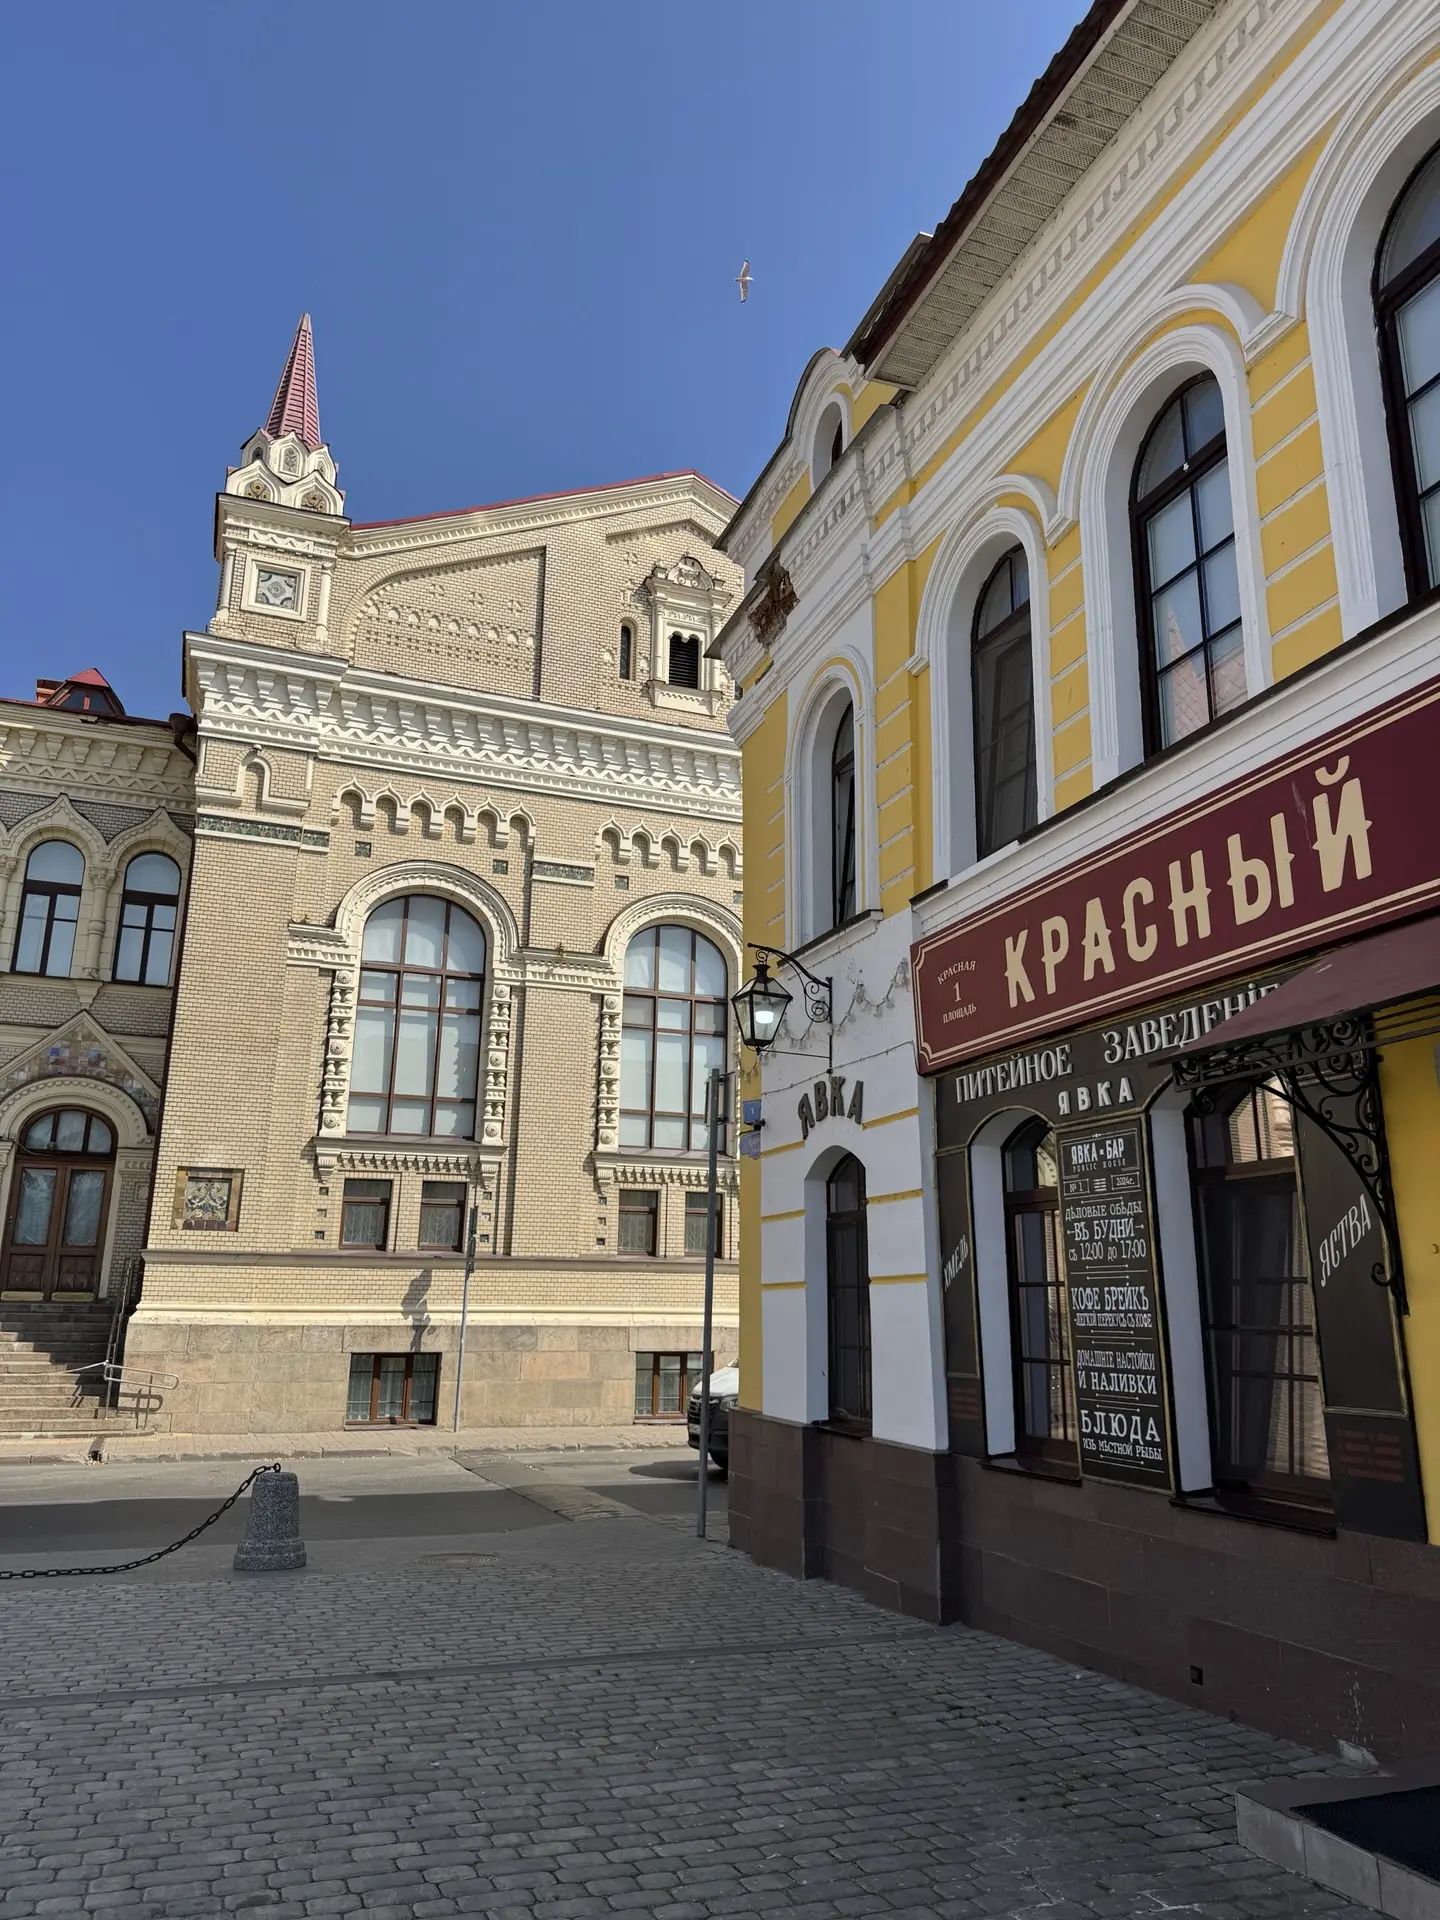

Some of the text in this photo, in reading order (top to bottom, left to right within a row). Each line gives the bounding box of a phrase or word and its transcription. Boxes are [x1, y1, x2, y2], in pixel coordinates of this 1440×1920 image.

[1004, 755, 1373, 1008] КРАСНЫЙ
[937, 960, 976, 985] КРАСНАЯ
[953, 981, 962, 1002] 1
[942, 1003, 977, 1024] ПЛОЩАДЬ
[955, 1044, 1073, 1103] ПИТЕЙНОЕ
[798, 1076, 864, 1140] ЯВКА
[1058, 1077, 1134, 1115] ЯВКА
[1073, 1158, 1126, 1172] PUBLIC HOUSE
[1074, 1217, 1135, 1242] ВЪ БУДНИ
[1319, 1193, 1371, 1288] ЯСТВА
[1080, 1241, 1104, 1260] 12:00
[1120, 1239, 1147, 1259] 17:00
[943, 1234, 968, 1291] ХМЕЛЬ
[1071, 1282, 1149, 1311] КОФЕ БРЕЙКЪ
[1115, 1349, 1156, 1371] НАСТОЙКИ
[1078, 1370, 1157, 1395] И НАЛИВКИ
[1080, 1409, 1161, 1445] БЛЮДА
[1135, 1445, 1163, 1460] РЫБЫ
